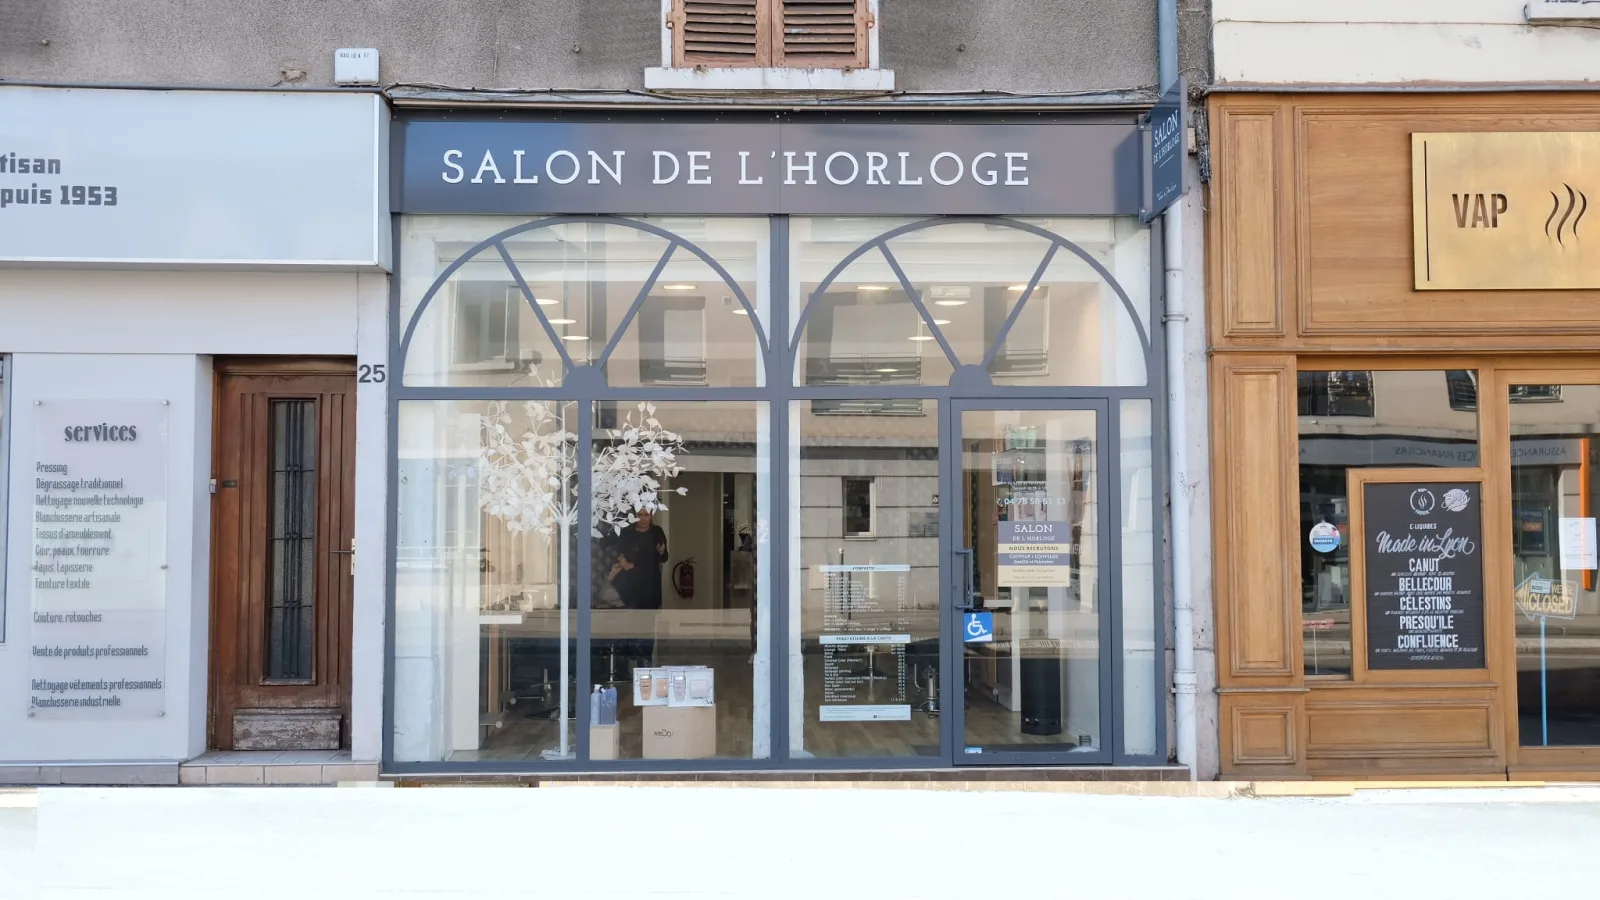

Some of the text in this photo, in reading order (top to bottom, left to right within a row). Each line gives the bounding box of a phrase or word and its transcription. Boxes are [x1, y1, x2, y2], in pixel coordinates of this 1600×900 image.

[1154, 109, 1179, 148] SALON
[442, 149, 1030, 186] SALON DE L'HORLOGE
[60, 185, 118, 206] 1953
[1452, 193, 1508, 229] VAP
[358, 364, 386, 383] 25
[64, 423, 137, 442] services
[36, 461, 67, 475] Pressing
[36, 477, 123, 492] Dégraissage traditionnel
[35, 494, 144, 509] Nettoyage nouvelle technologie
[35, 511, 121, 523] Blanchisserie artisanale
[35, 527, 58, 539] Tissus
[1014, 524, 1053, 533] SALON
[76, 544, 110, 556] fourrure
[1376, 527, 1475, 559] Made in Lyon
[56, 560, 93, 575] tapisserie
[1409, 558, 1440, 572] CANUT
[34, 577, 90, 589] Teinture textile
[1399, 576, 1452, 591] BELLECOUR
[1399, 594, 1452, 611] CÉLESTINS
[1528, 593, 1573, 614] CLOSED
[65, 610, 102, 622] retouches
[1400, 615, 1454, 631] PRESQU'ILE
[1397, 634, 1459, 649] CONFLUENCE
[32, 644, 148, 660] Vente de produits professionnels
[31, 677, 162, 693] Nettoyage vêtements professionnels
[31, 695, 121, 708] Blanchisserie industrielle
